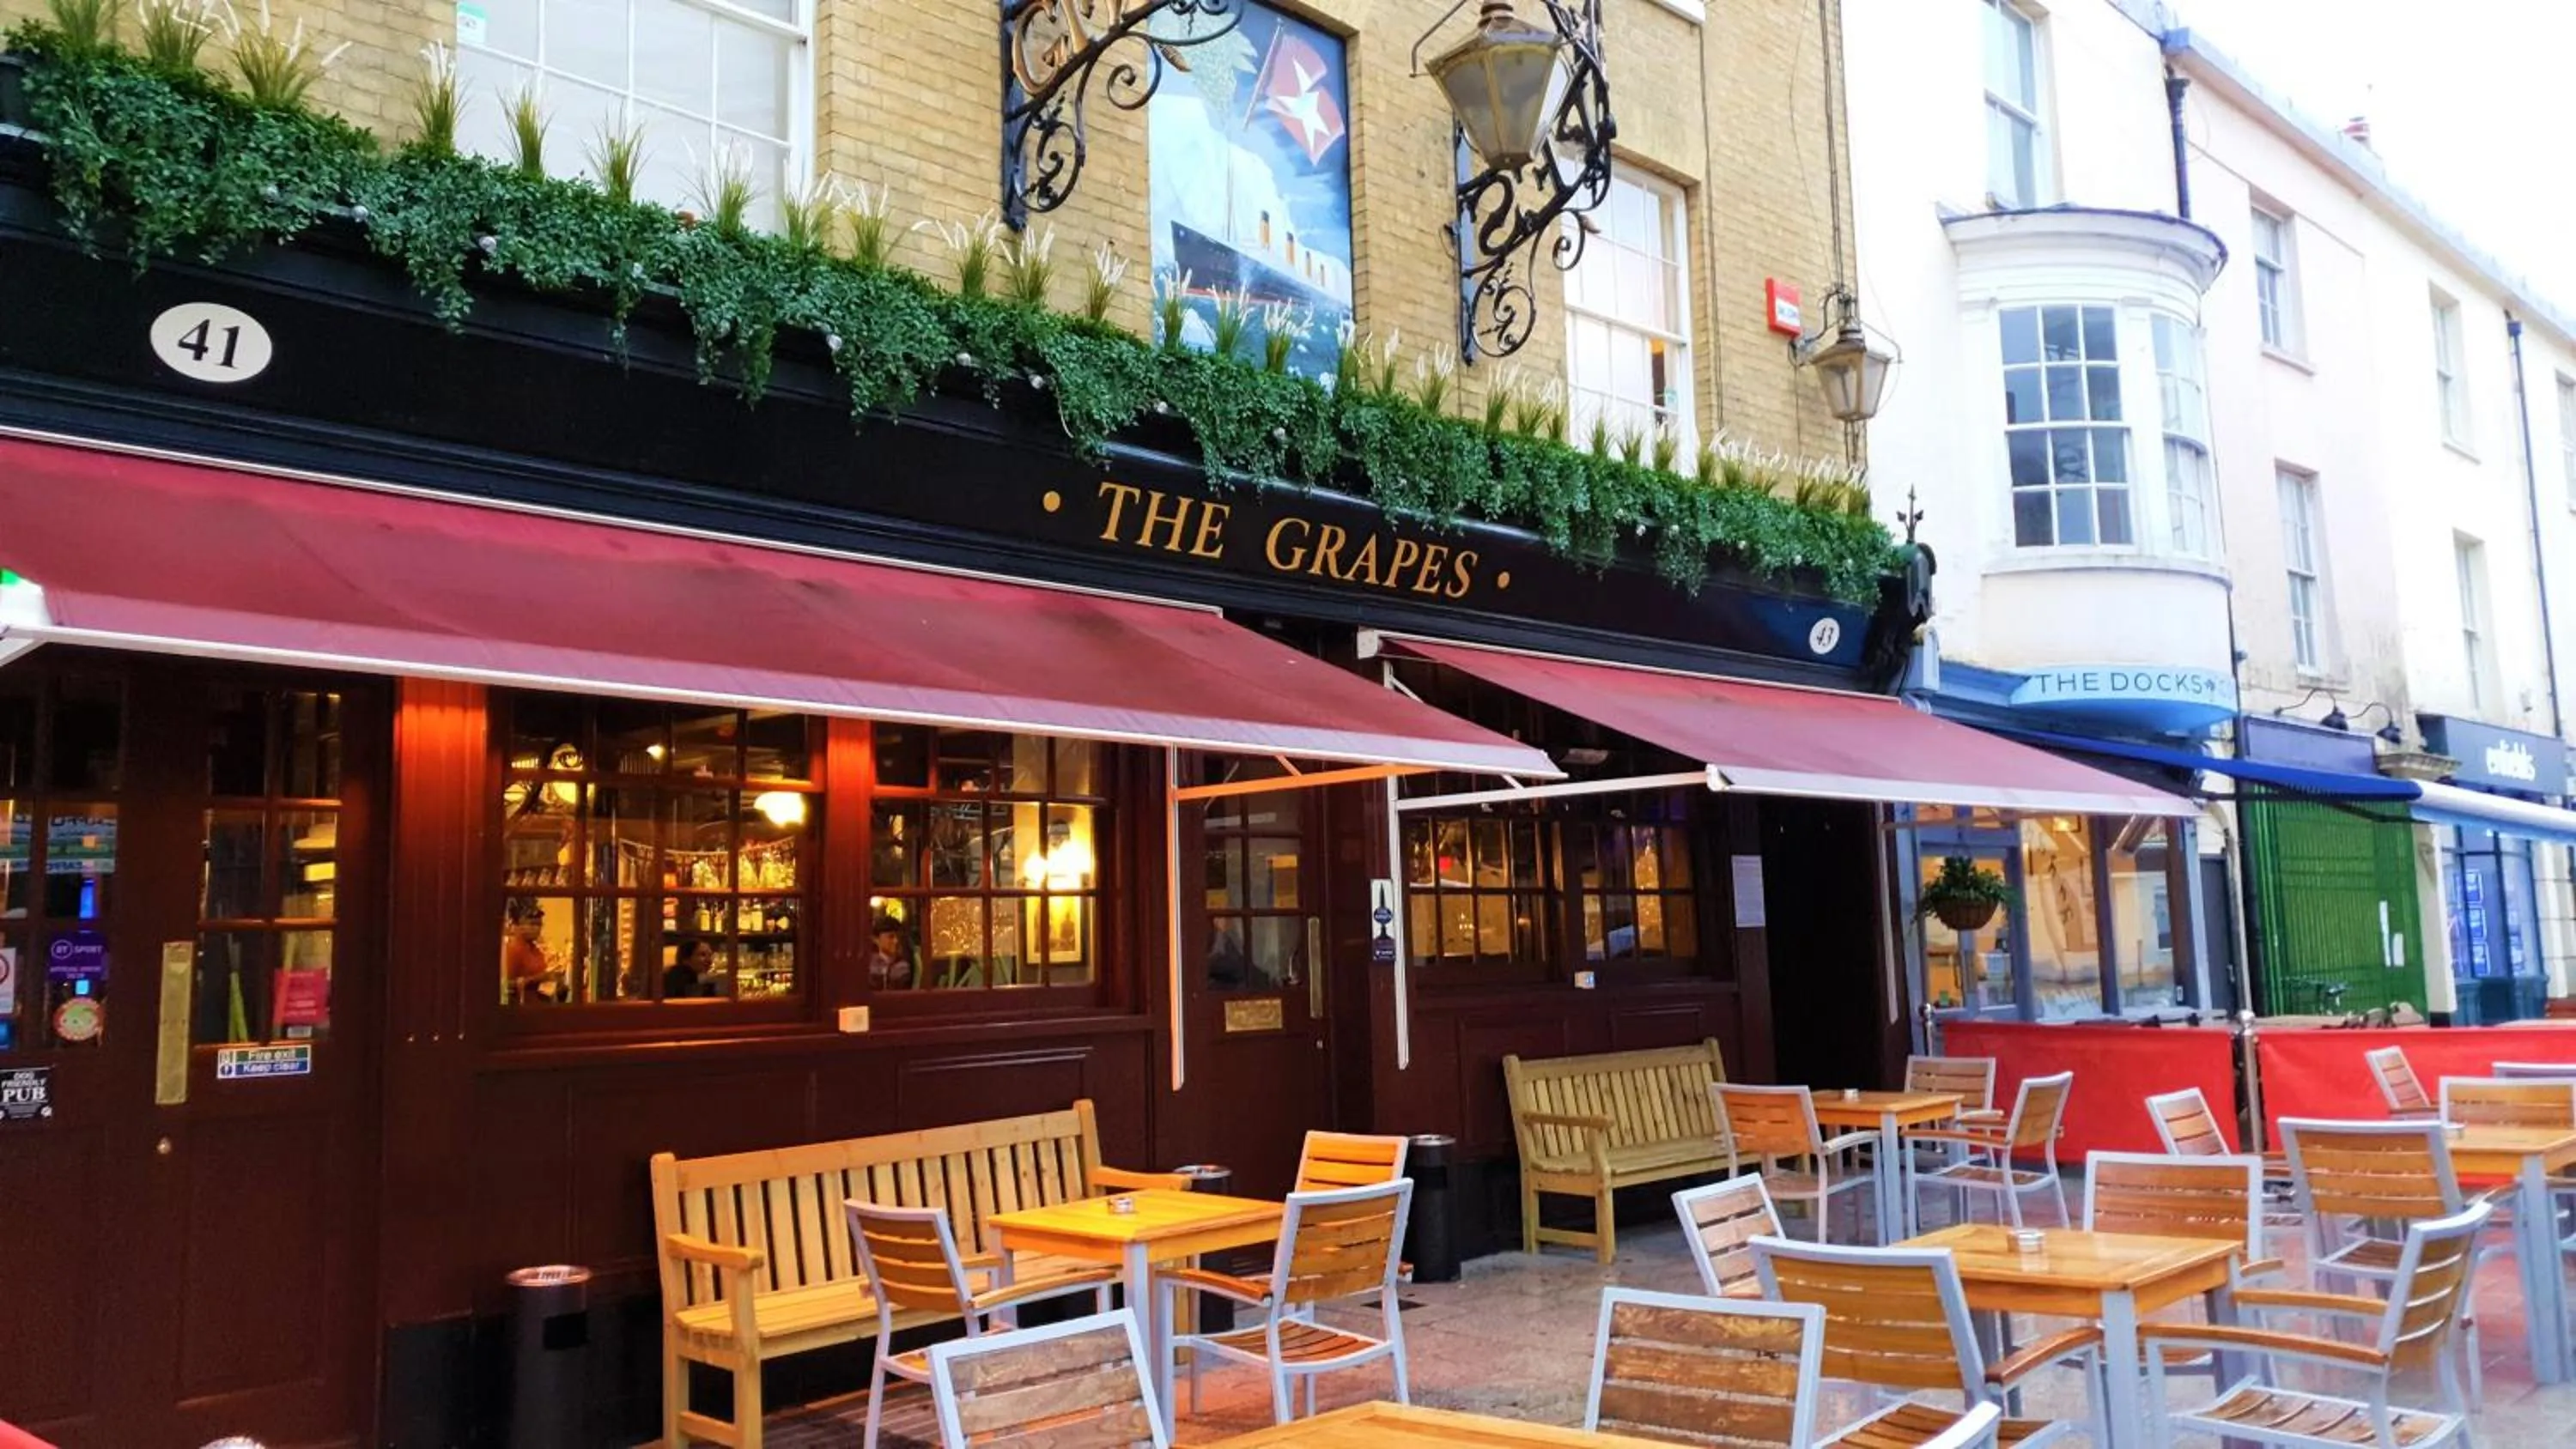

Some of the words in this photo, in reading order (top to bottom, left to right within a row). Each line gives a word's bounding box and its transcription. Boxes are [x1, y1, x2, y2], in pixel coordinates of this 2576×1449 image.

[178, 318, 240, 369] 41
[1098, 482, 1230, 560] THE
[1265, 517, 1479, 598] GRAPES
[2035, 672, 2099, 694] THE
[2110, 672, 2203, 695] DOCKS
[3, 1087, 46, 1103] PUB
